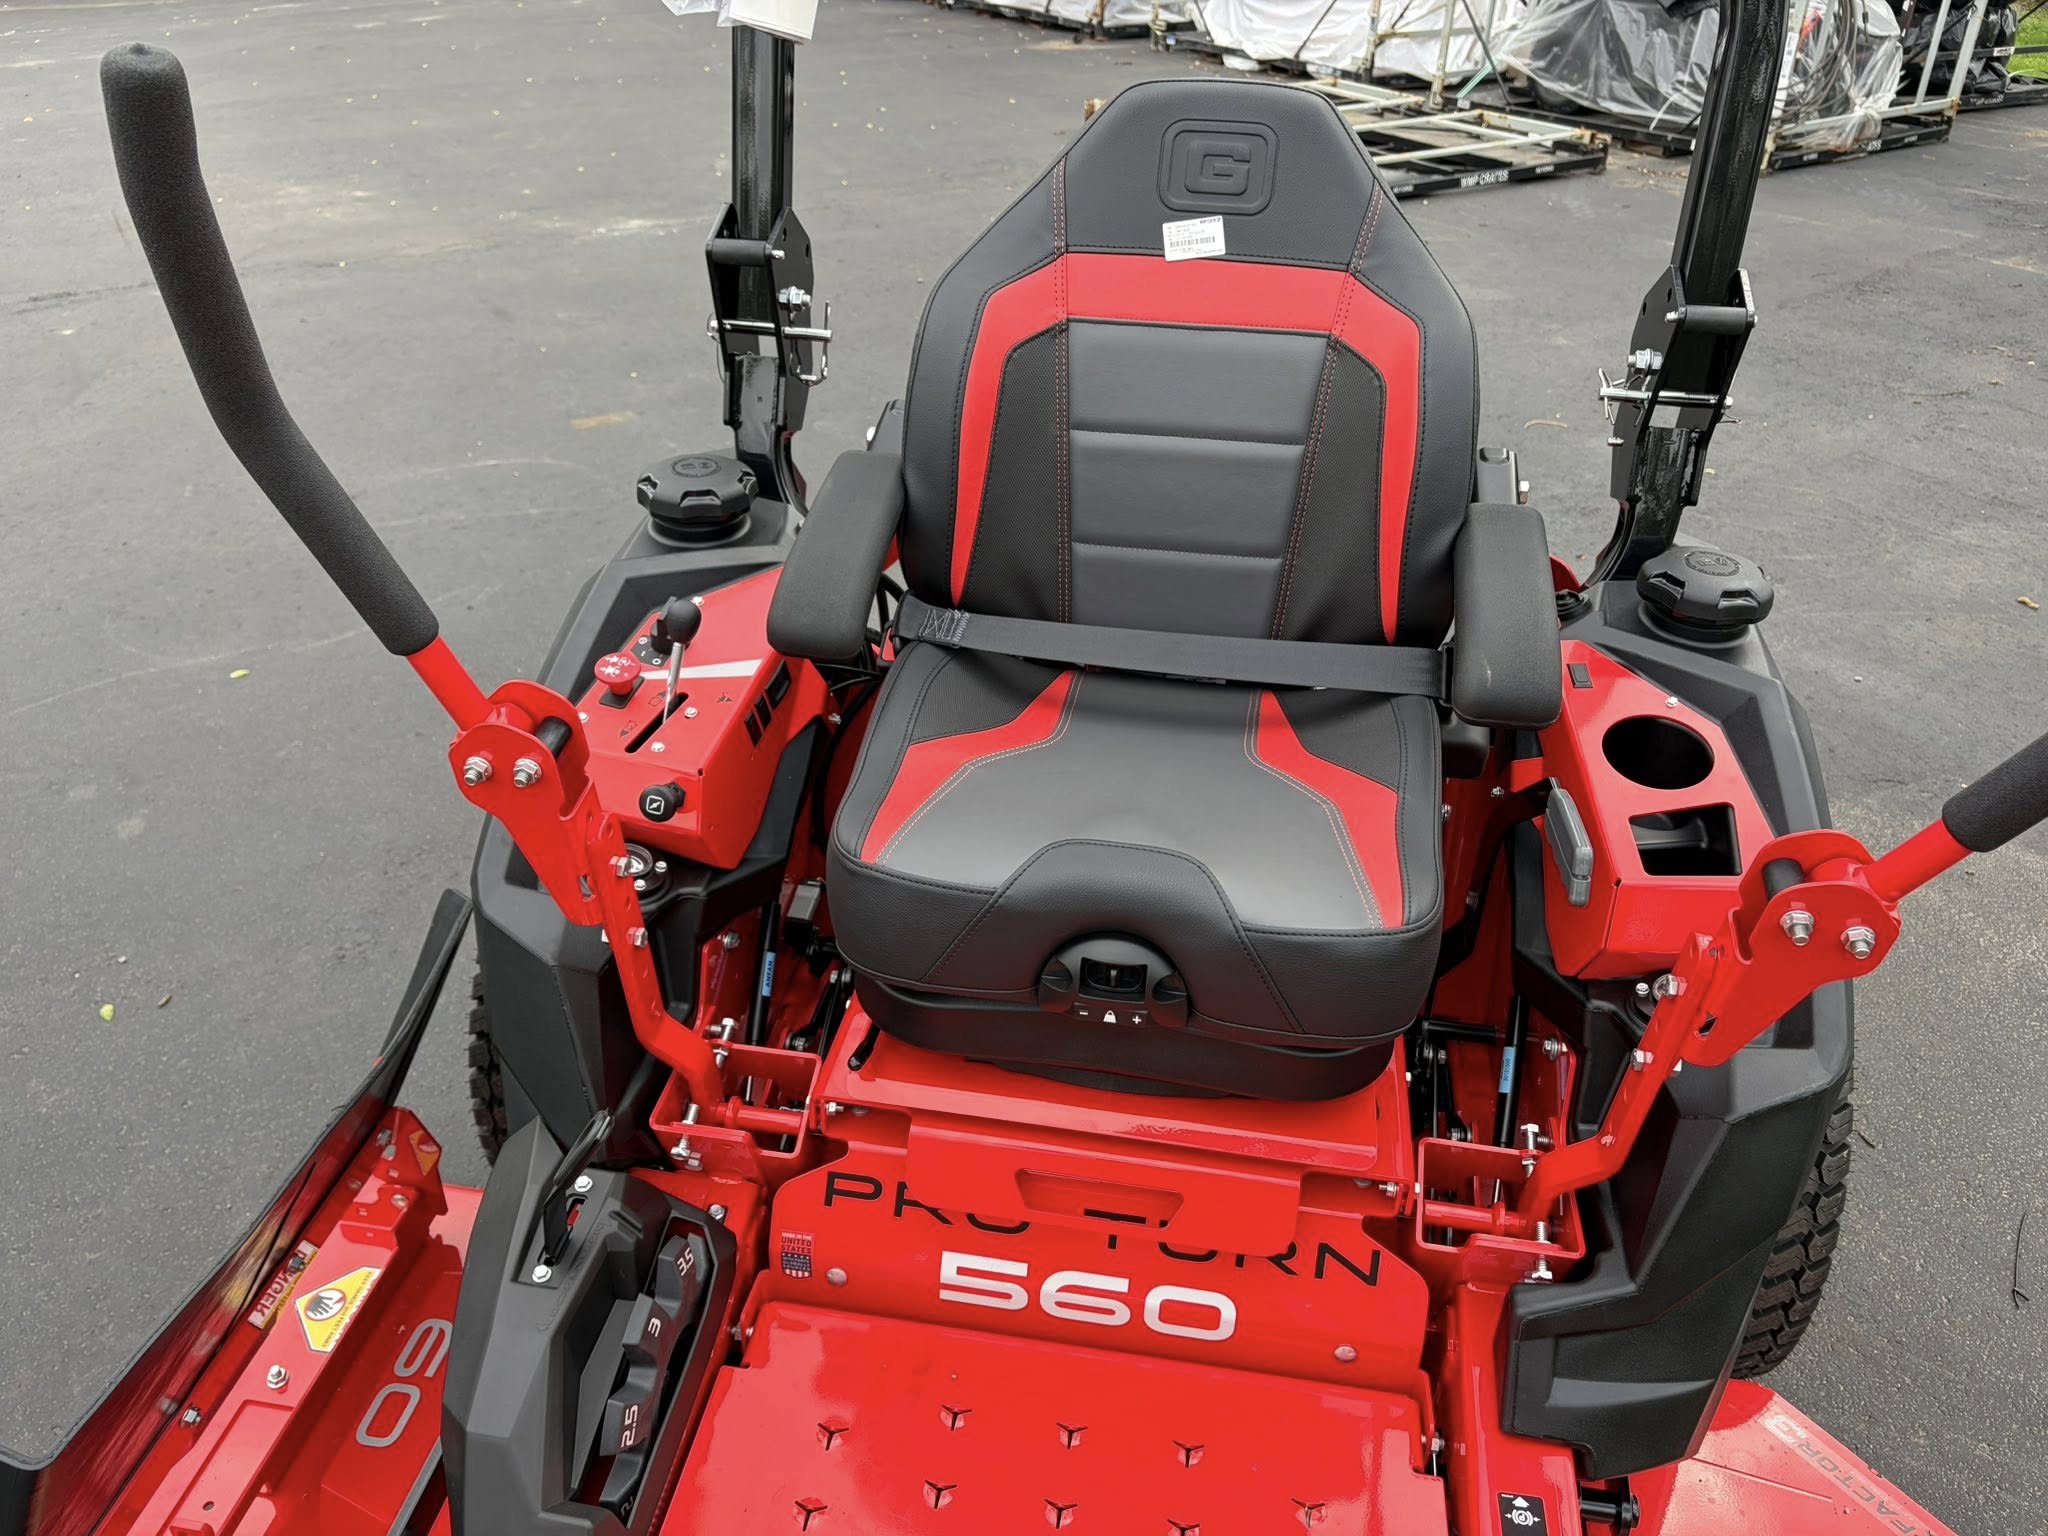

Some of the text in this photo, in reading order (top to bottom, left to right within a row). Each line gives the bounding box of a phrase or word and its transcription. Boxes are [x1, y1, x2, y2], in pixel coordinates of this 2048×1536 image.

[781, 1236, 812, 1247] UNITED
[781, 1244, 812, 1255] STATES
[938, 1250, 1237, 1342] 560
[648, 1317, 662, 1337] 3
[355, 1318, 453, 1448] 60
[621, 1404, 638, 1448] 2.5
[1797, 1439, 1917, 1534] FACTOR
